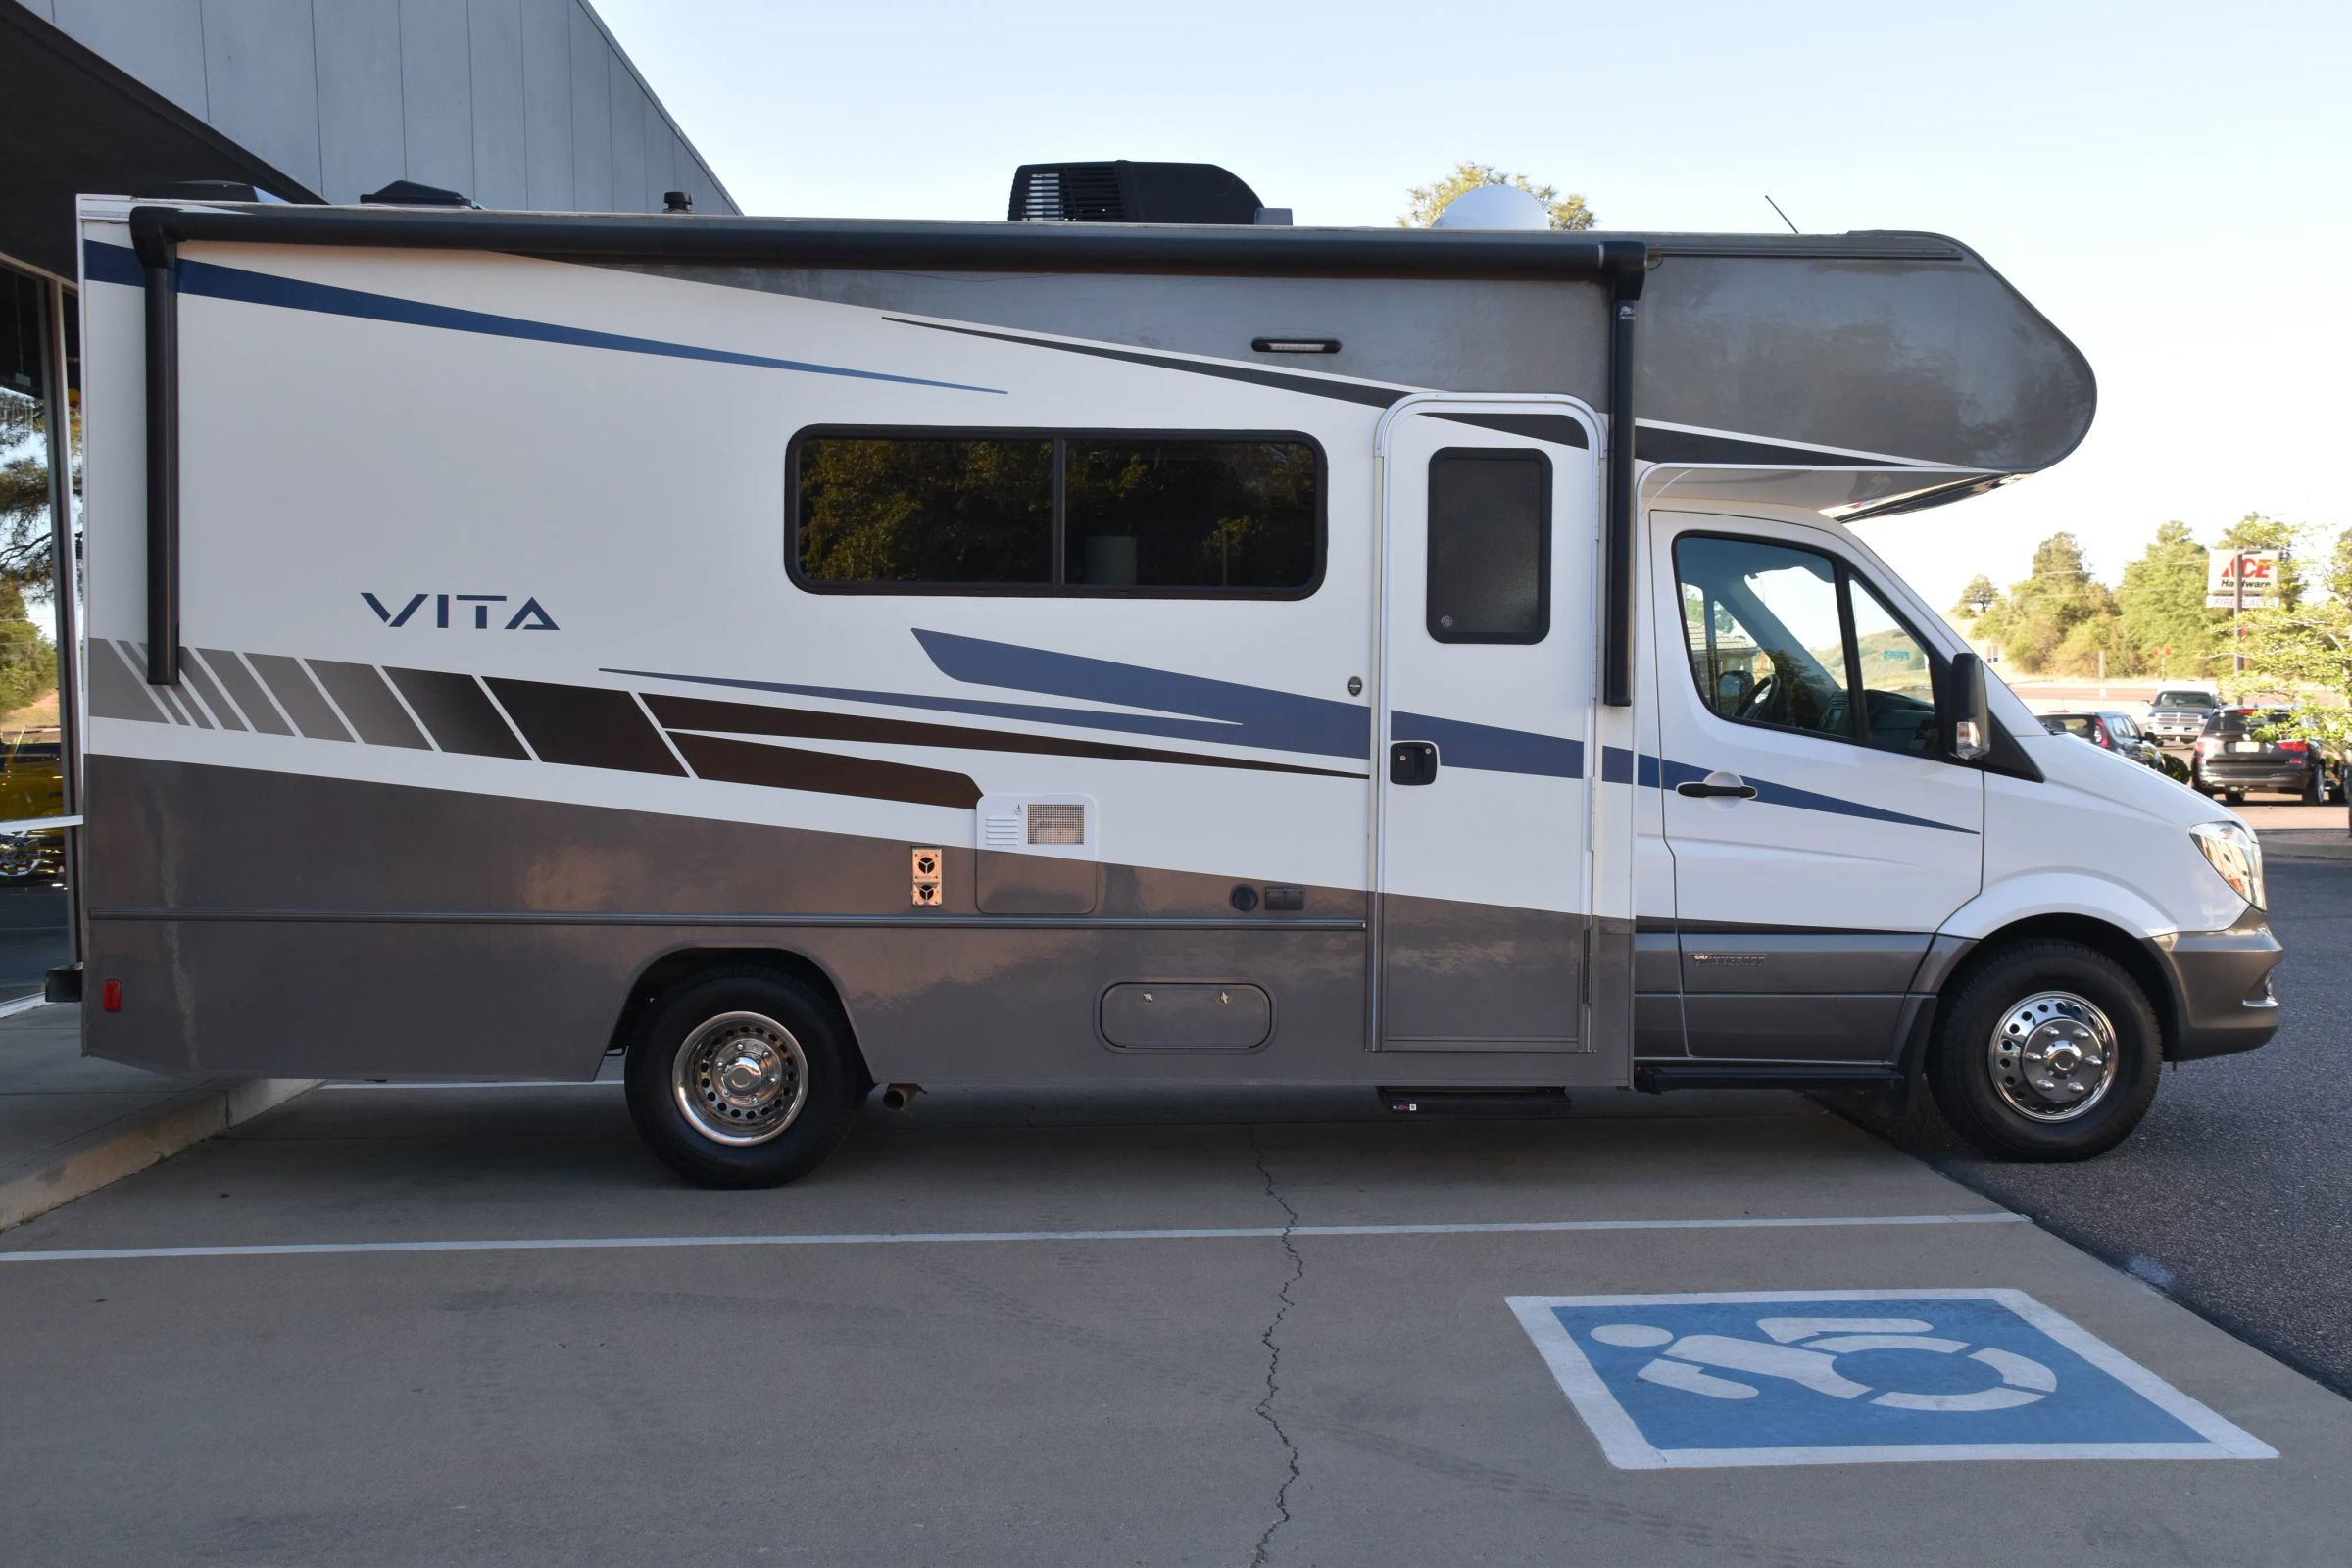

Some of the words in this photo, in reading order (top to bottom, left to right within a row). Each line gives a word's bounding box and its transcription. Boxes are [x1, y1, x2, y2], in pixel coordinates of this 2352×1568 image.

[2221, 556, 2273, 578] ACE
[2221, 579, 2271, 588] Hadware
[360, 592, 561, 630] VITA
